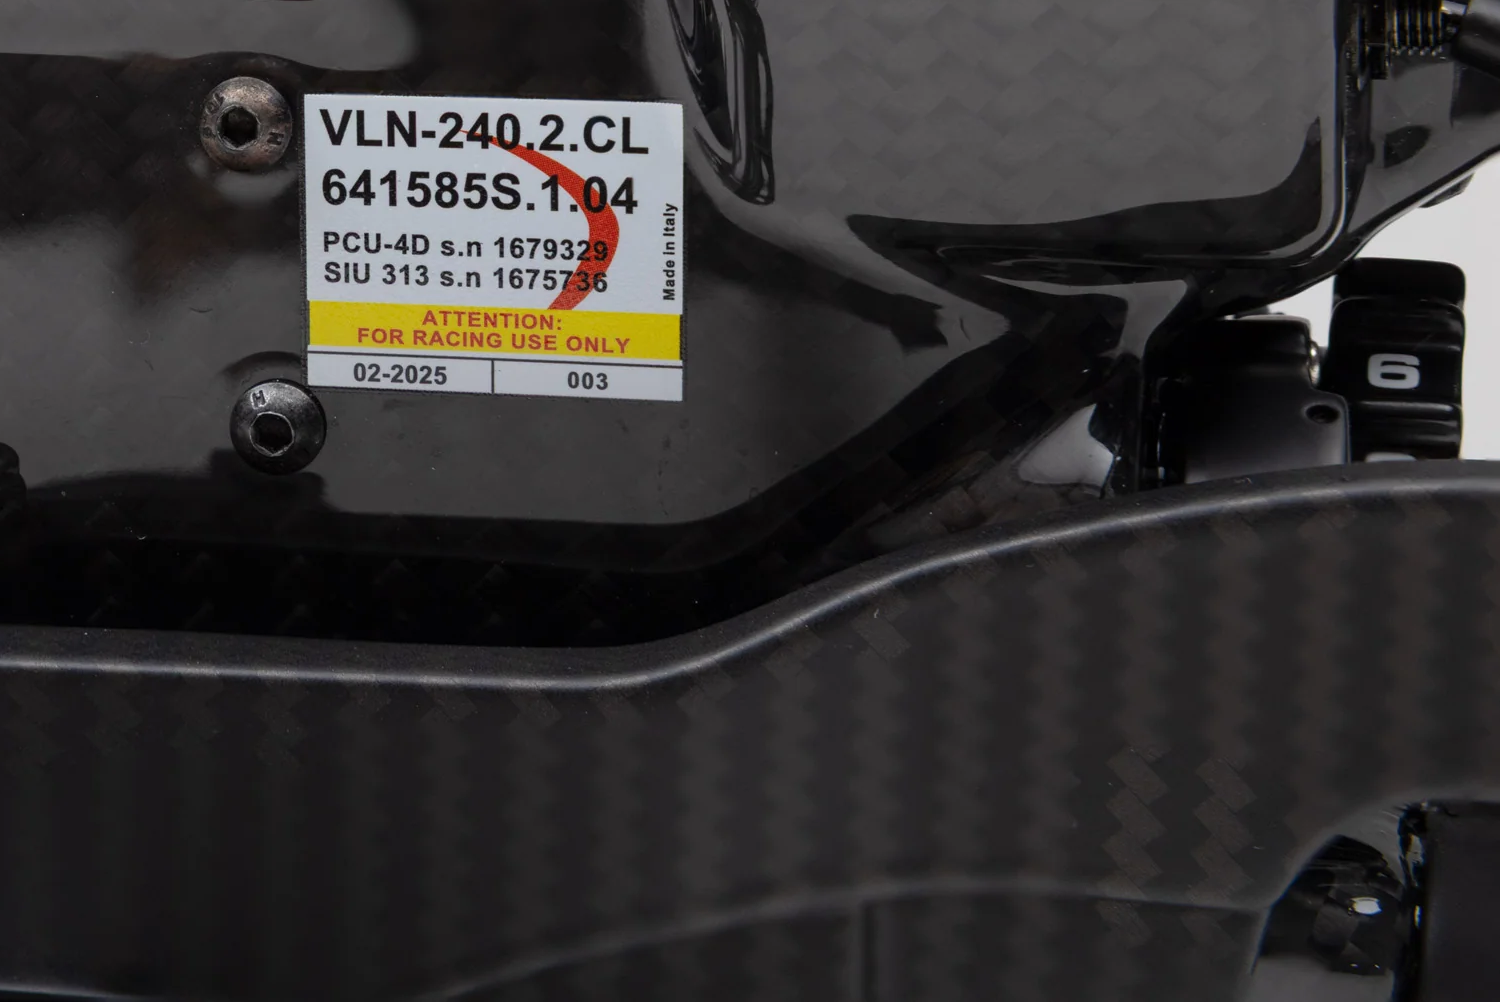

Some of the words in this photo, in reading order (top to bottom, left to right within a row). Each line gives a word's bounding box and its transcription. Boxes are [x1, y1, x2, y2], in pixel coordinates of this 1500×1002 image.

[319, 108, 650, 155] VLN-240.2.CL
[321, 168, 639, 215] 641585S.1.04
[662, 202, 679, 237] Italy
[322, 230, 431, 257] PCU-4D
[440, 238, 483, 258] s.n
[493, 237, 610, 263] 1679329
[323, 260, 372, 285] SIU
[381, 262, 430, 287] 313
[439, 270, 482, 289] s.n
[493, 266, 609, 294] 1675736
[662, 259, 676, 301] Made
[421, 309, 564, 331] ATTENTION:
[356, 326, 405, 346] FOR
[412, 329, 503, 350] RACING
[510, 334, 558, 352] USE
[565, 335, 631, 355] ONLY
[352, 362, 449, 387] 02-2025
[566, 371, 610, 391] 003
